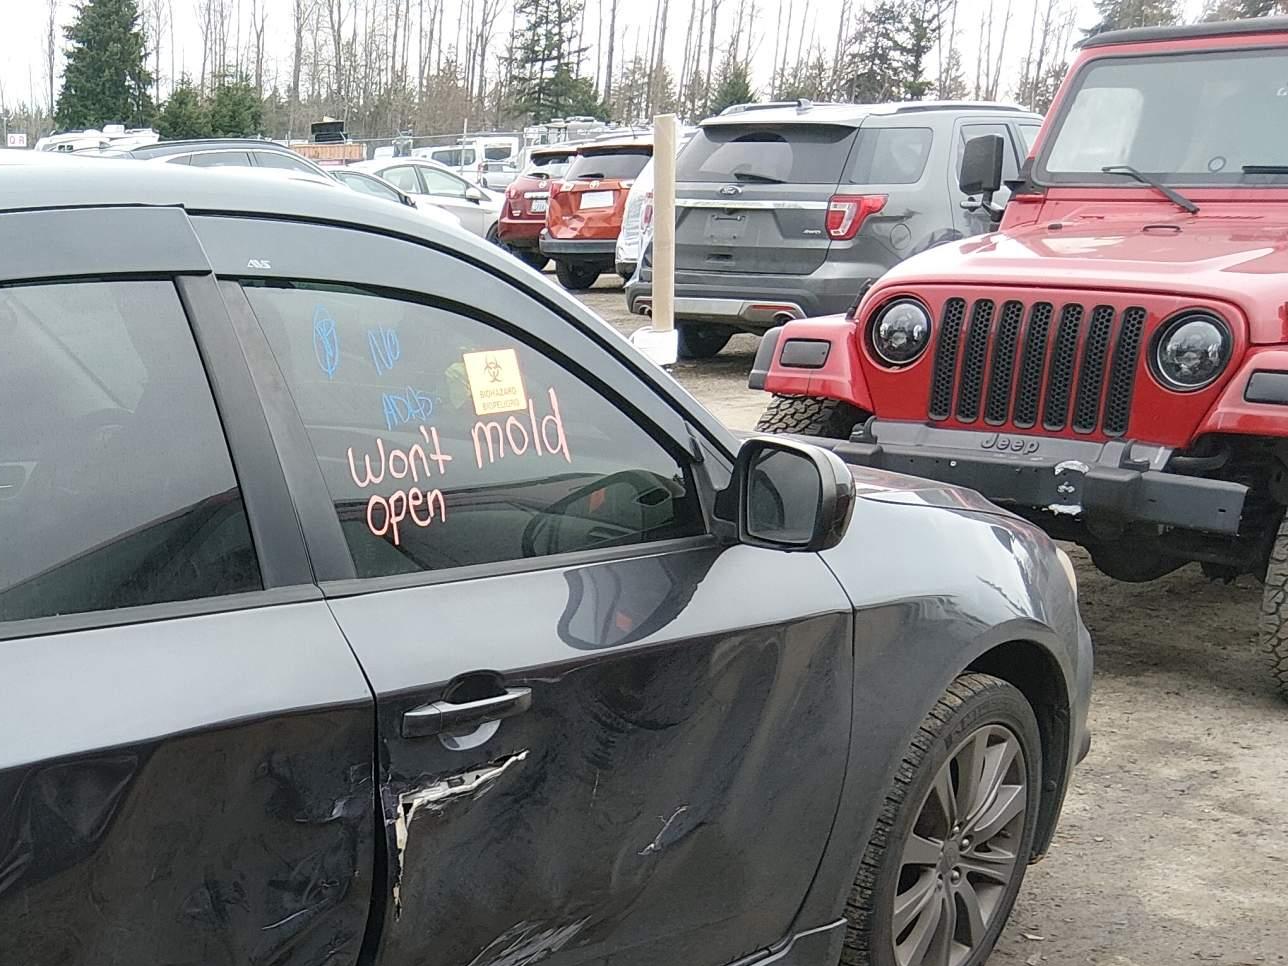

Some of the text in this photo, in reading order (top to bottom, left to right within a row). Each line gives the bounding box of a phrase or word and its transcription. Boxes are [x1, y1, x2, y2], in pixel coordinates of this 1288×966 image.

[479, 386, 517, 399] BIOHAZARD
[472, 387, 572, 469] mold
[981, 433, 1040, 455] Jeep
[367, 487, 446, 545] open
